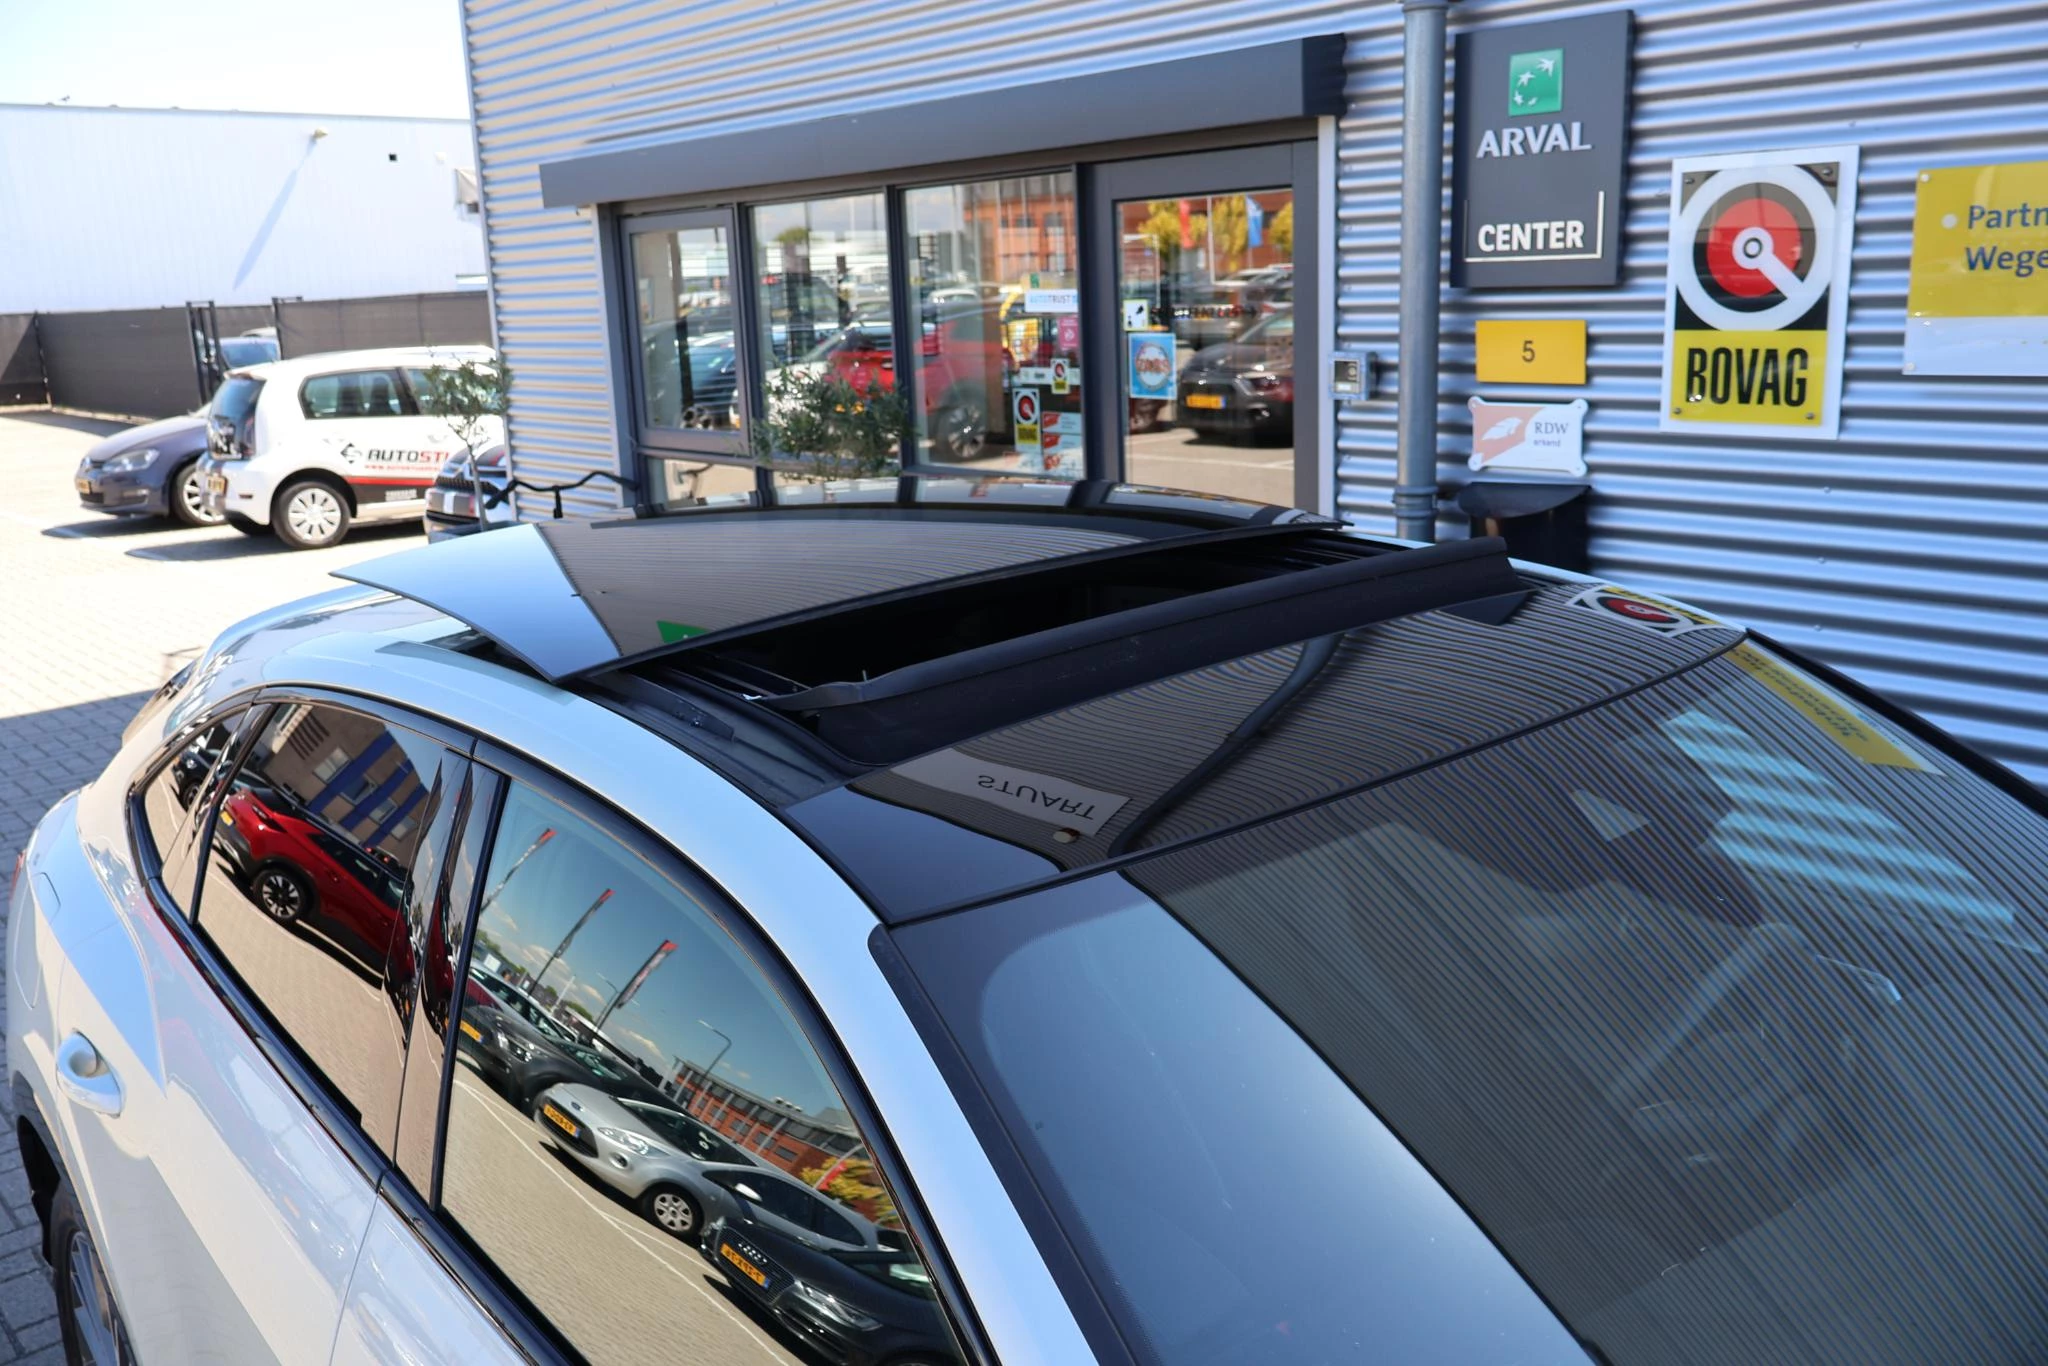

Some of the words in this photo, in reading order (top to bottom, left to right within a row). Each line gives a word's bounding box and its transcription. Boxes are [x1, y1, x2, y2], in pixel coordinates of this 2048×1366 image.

[1476, 121, 1592, 159] ARVAL
[1478, 220, 1585, 252] CENTER
[1521, 339, 1536, 363] 5
[1685, 346, 1809, 407] BOVAG
[1534, 422, 1569, 435] RDW
